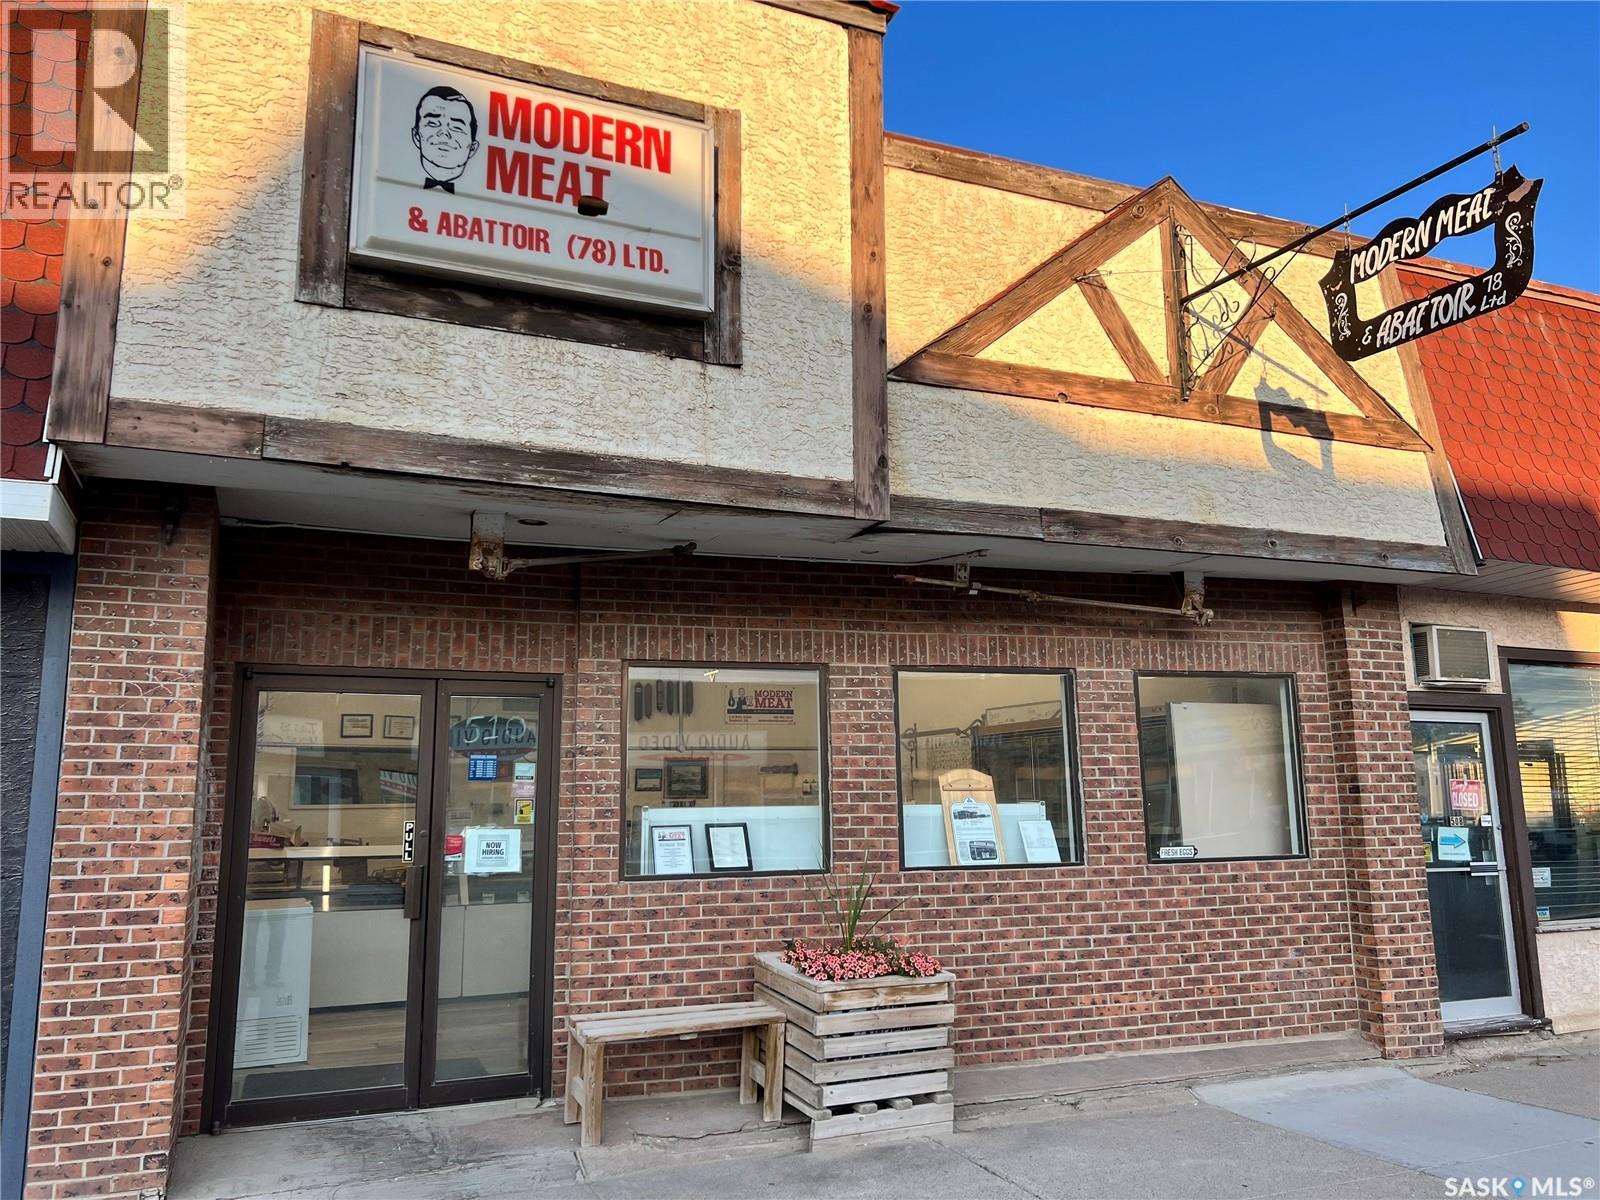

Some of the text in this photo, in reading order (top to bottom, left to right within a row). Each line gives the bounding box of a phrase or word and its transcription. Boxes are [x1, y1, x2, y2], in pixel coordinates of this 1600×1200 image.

[488, 91, 671, 174] MODERN
[486, 145, 611, 208] MEAT
[408, 206, 669, 274] & ABATTOIR (78) LTD.
[1350, 188, 1496, 283] MODERN MEAT
[1483, 272, 1503, 292] 78
[1362, 282, 1477, 348] & ABATTOIR
[1480, 290, 1507, 312] Ltd
[754, 690, 793, 698] MODERN
[754, 698, 793, 708] MEAT
[464, 714, 526, 743] 510
[1452, 792, 1478, 807] CLOSED
[403, 822, 414, 861] PULL
[1161, 848, 1178, 857] FRESH
